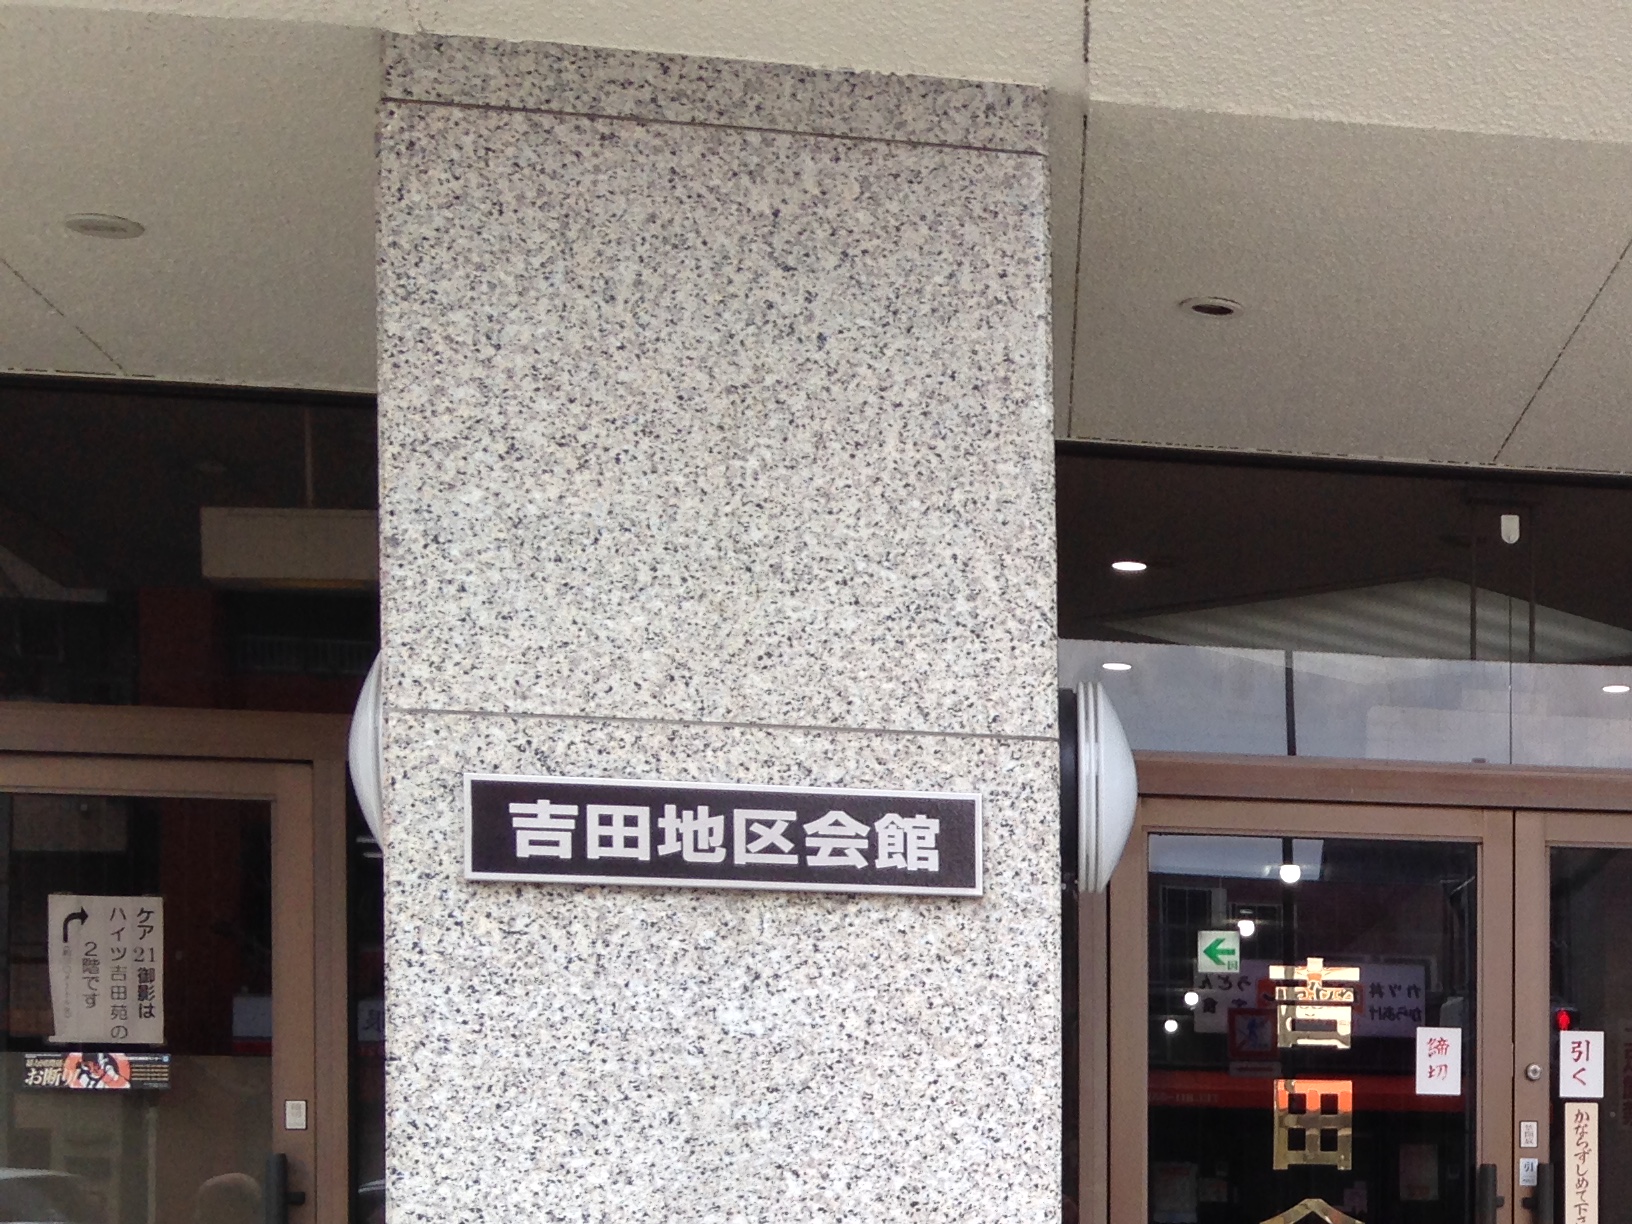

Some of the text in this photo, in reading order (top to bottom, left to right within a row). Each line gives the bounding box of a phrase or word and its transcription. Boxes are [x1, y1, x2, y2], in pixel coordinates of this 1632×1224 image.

[508, 799, 940, 873] 吉田地区会館
[110, 907, 129, 1040] ハイツ吉田苑の
[1426, 1036, 1450, 1082] 締切
[1570, 1039, 1592, 1087] 引く
